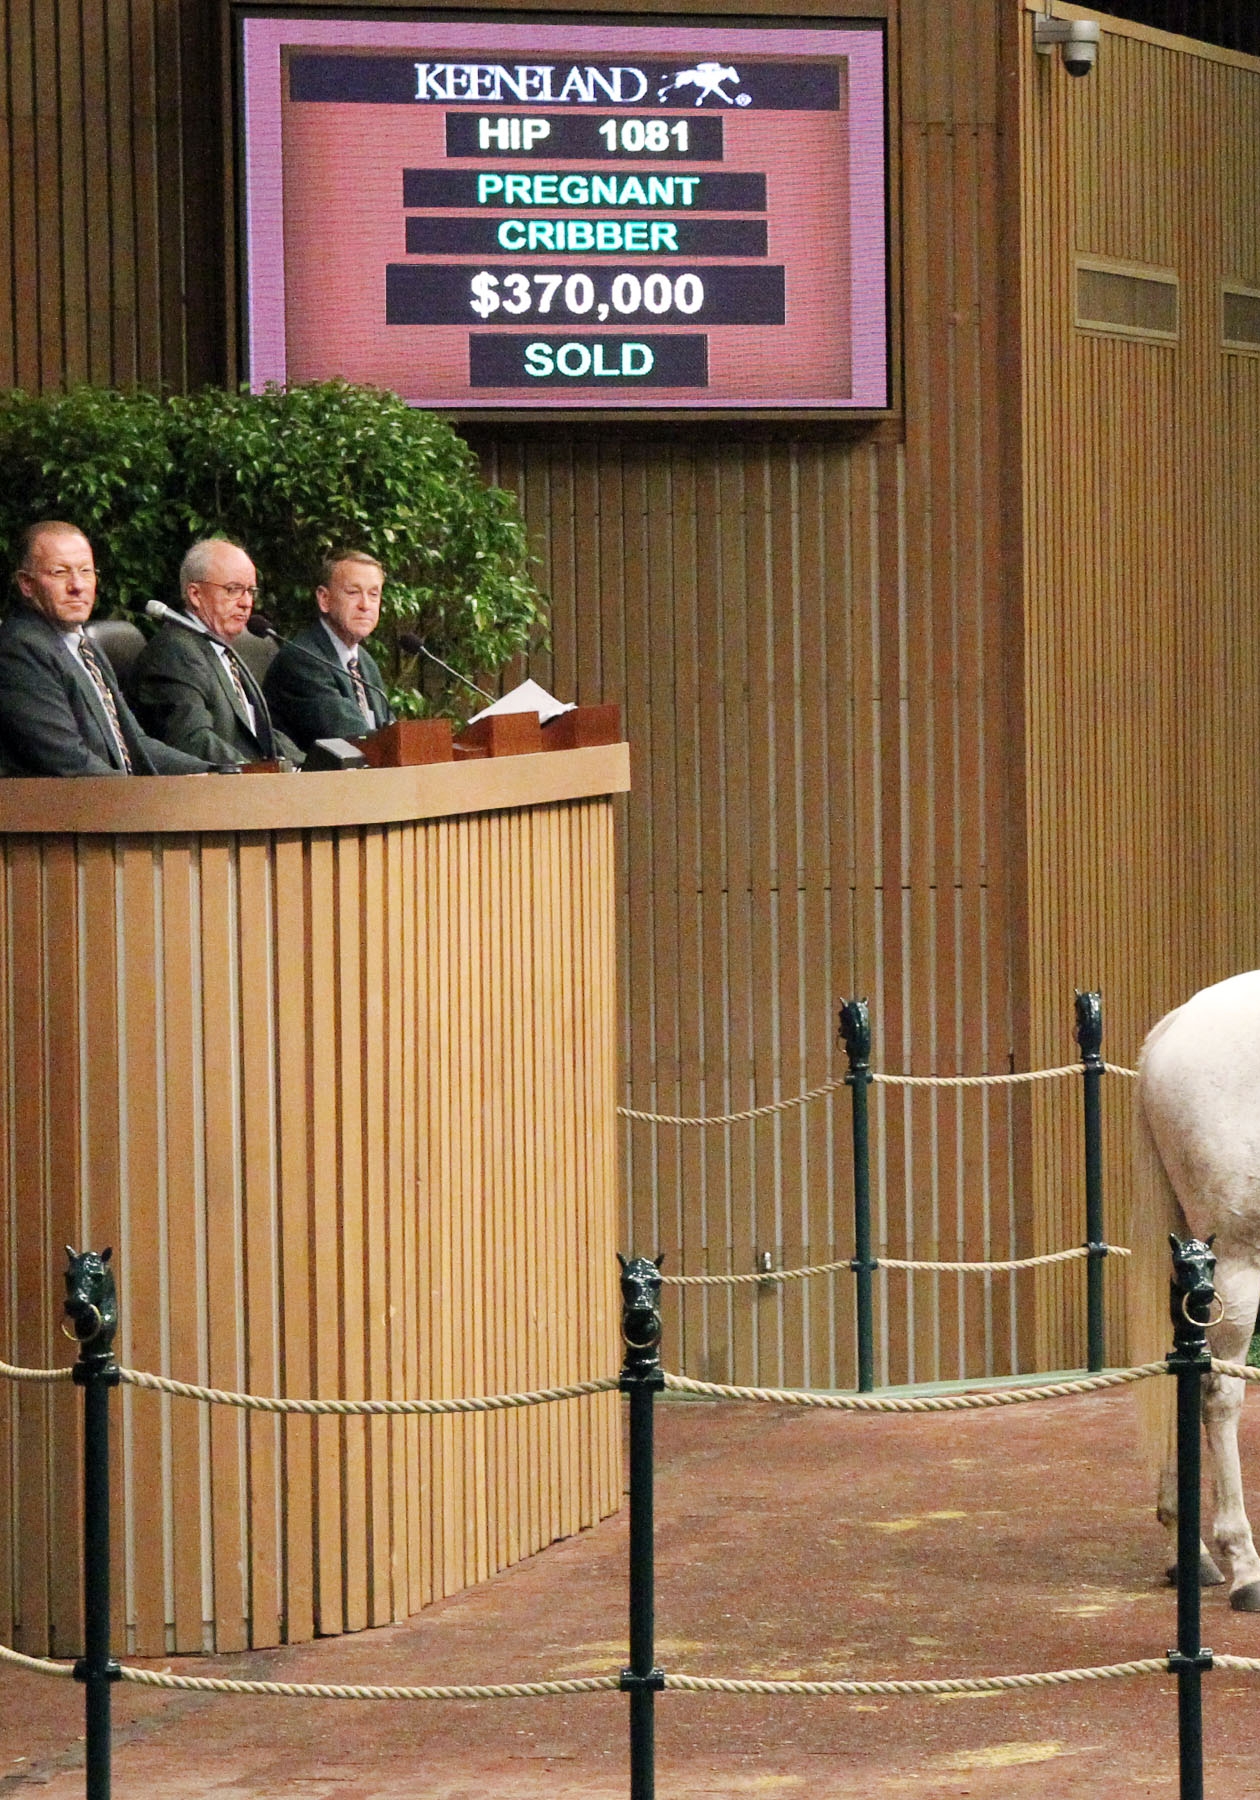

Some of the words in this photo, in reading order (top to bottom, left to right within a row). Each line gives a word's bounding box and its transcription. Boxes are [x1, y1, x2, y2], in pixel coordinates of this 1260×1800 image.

[415, 63, 647, 102] KEENELAND
[478, 118, 550, 150] HIP
[599, 119, 689, 152] 1081
[477, 174, 700, 206] PREGNANT
[498, 220, 678, 251] CRIBBER
[470, 271, 704, 321] $370,000
[524, 343, 654, 377] SOLD
